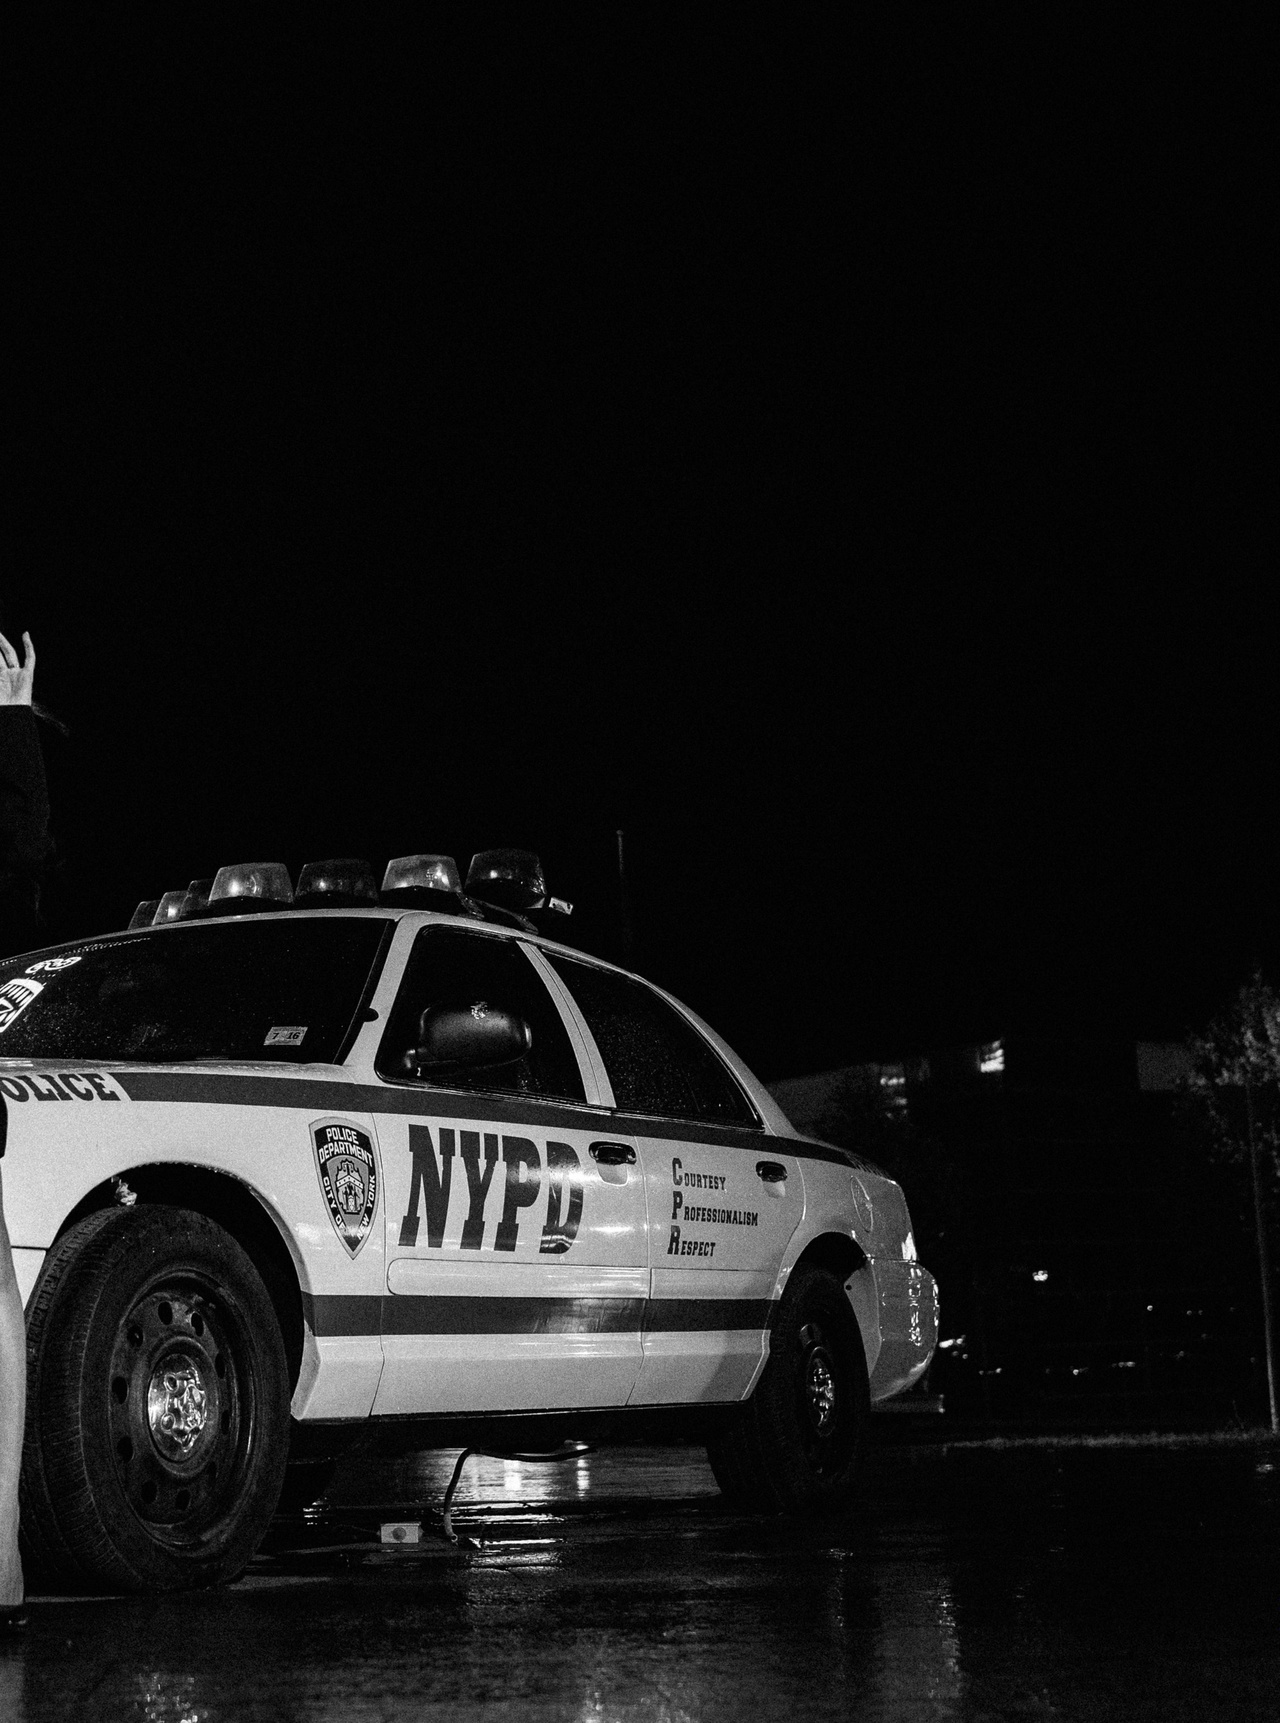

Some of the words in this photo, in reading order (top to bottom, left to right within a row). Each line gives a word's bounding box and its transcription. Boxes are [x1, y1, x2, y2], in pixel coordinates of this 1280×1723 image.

[319, 1142, 373, 1168] DEPARTMENT
[326, 1127, 359, 1145] POLICE
[323, 1176, 337, 1209] CITY
[335, 1214, 347, 1232] OF
[357, 1213, 370, 1241] NEW
[367, 1175, 376, 1208] YORK
[398, 1123, 584, 1254] NYPD
